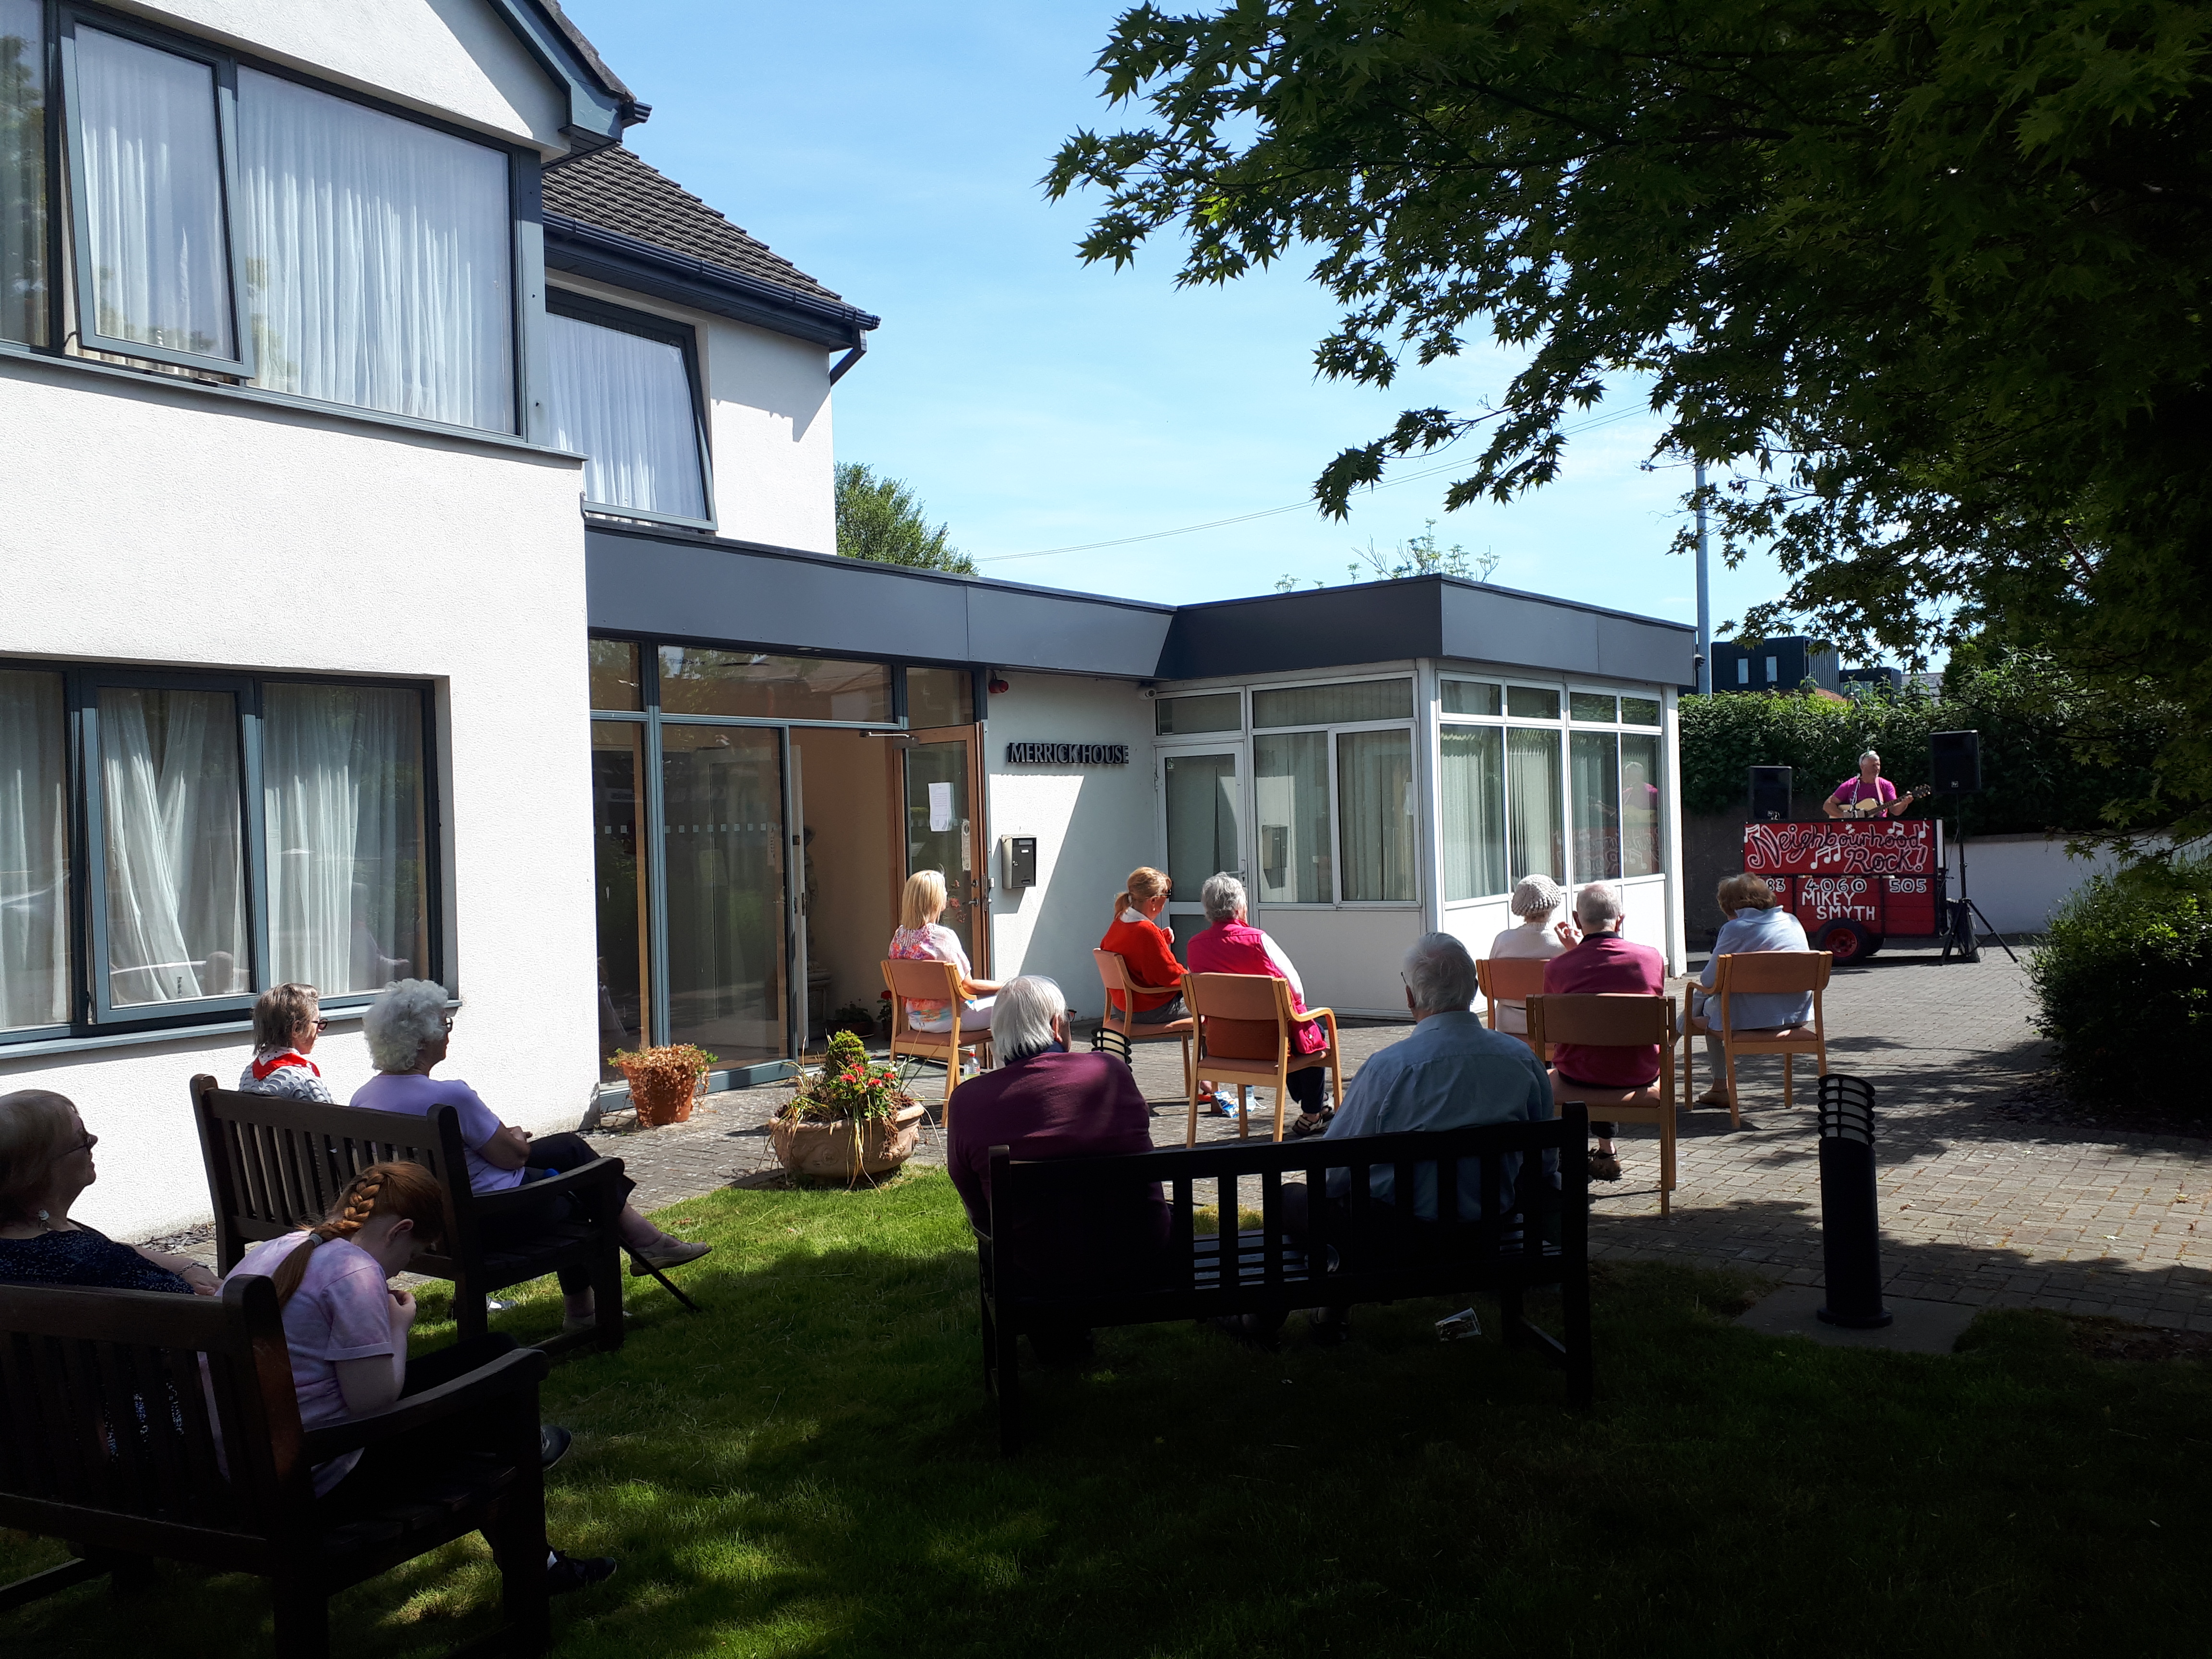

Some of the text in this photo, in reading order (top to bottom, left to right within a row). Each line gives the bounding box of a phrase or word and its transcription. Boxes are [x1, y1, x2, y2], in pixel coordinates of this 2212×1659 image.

[1008, 742, 1129, 764] MERRICK HOUSE
[1747, 823, 1921, 869] Neighbourhood
[1761, 878, 1927, 893] 83 4060 505
[1802, 891, 1856, 906] MIKEY
[1816, 906, 1875, 921] SMYTH
